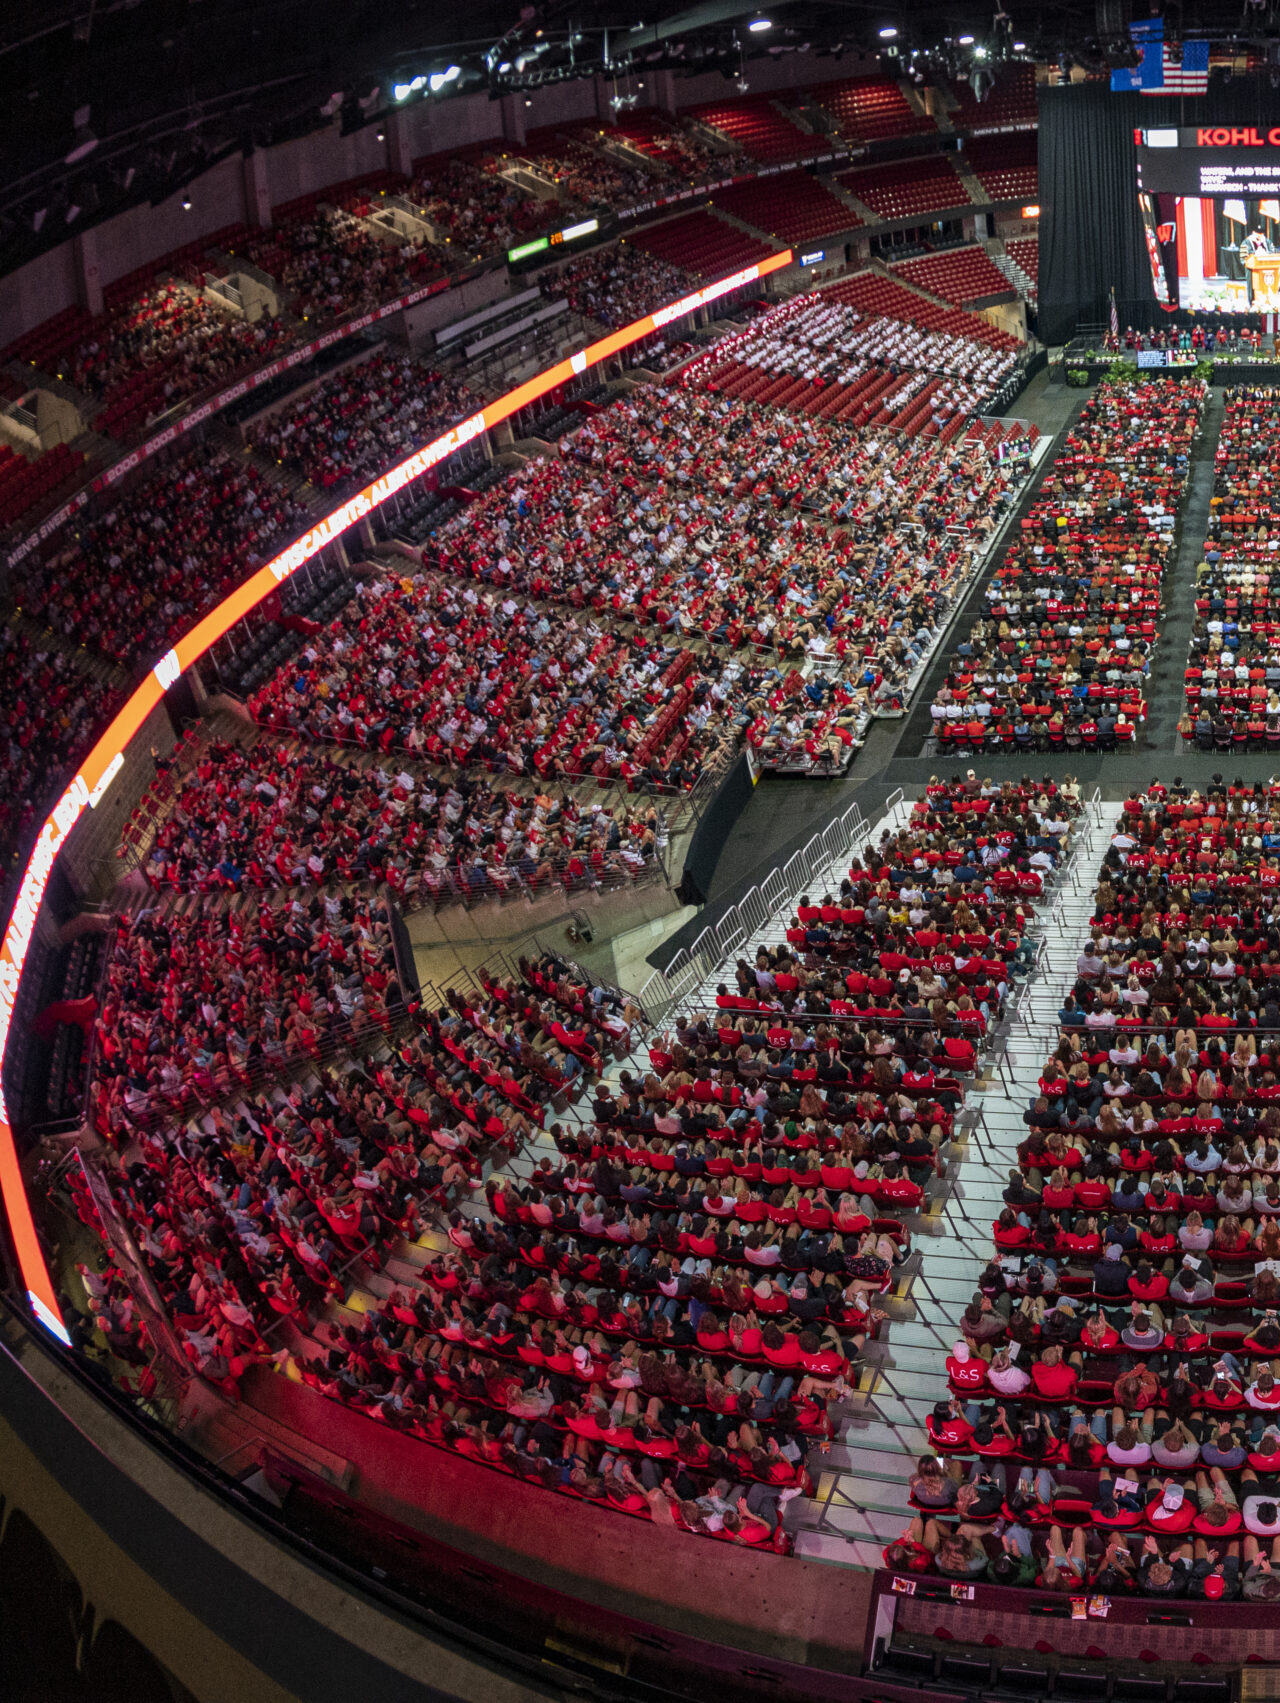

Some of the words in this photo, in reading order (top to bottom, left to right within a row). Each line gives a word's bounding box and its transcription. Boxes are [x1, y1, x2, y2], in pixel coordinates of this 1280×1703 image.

[1196, 127, 1265, 146] KOHL
[1248, 183, 1278, 192] THANK
[7, 532, 40, 569] MEN'S
[39, 504, 72, 539] SWEET
[107, 452, 141, 483] 2000
[145, 427, 177, 456] 2003
[182, 402, 213, 430] 2005
[218, 382, 247, 406] 2008
[254, 364, 279, 385] 2011
[287, 346, 313, 366] 2012
[318, 329, 343, 348] 2014
[408, 288, 429, 303] 2017
[1261, 873, 1276, 883] L&S
[933, 962, 952, 972] L&S
[1132, 967, 1150, 976] L&S
[1041, 1084, 1062, 1094] L&S
[949, 1366, 979, 1381] L&S
